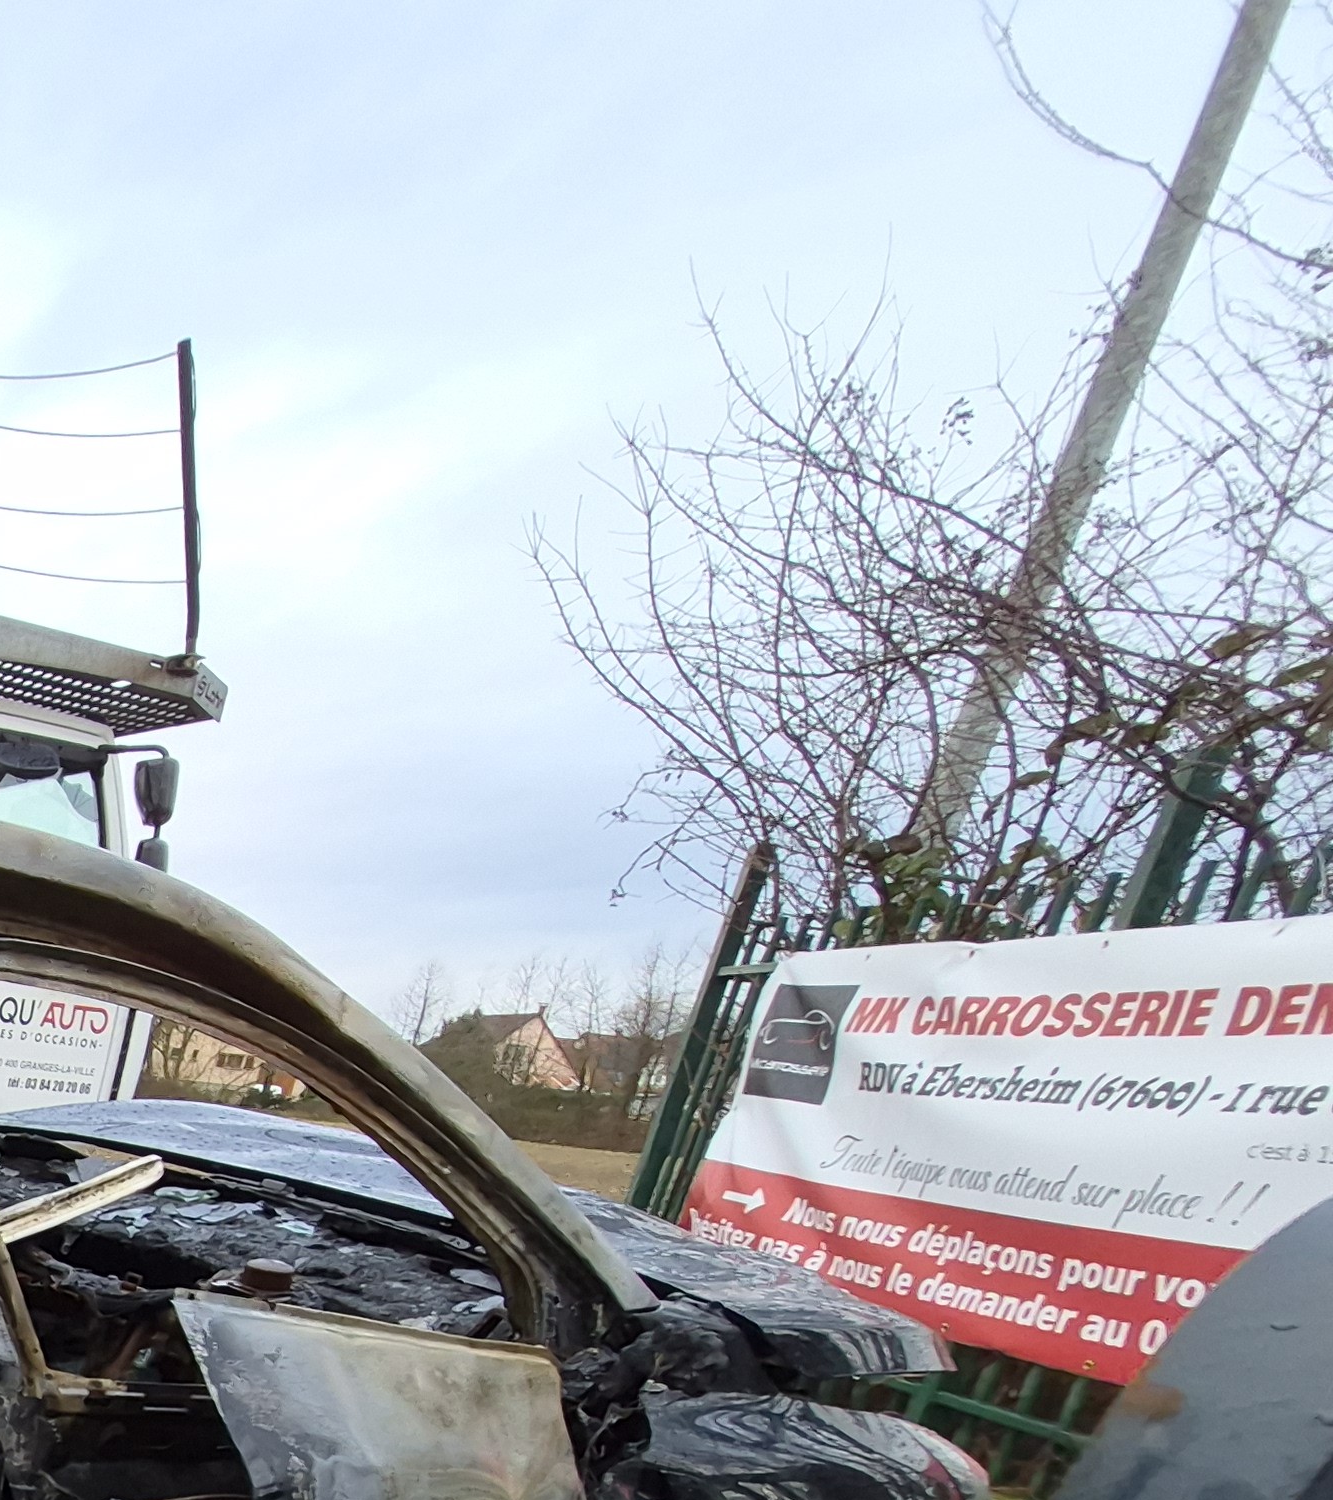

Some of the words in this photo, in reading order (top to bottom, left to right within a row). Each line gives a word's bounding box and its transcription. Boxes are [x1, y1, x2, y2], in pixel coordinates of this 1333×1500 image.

[845, 996, 910, 1034] MK
[912, 988, 1221, 1037] CARROSSERIE
[20, 1060, 96, 1077] GRANGES-LA-VILLE
[52, 1080, 65, 1092] 20
[65, 1081, 78, 1093] 20
[858, 1062, 907, 1094] RDV
[901, 1061, 924, 1093] à
[916, 1063, 1083, 1104] Ebersheim
[1077, 1073, 1213, 1118] (67600)
[1244, 1084, 1330, 1116] rue
[1246, 1143, 1294, 1161] c'est
[820, 1134, 884, 1175] Toute
[881, 1145, 947, 1198] l'équipe
[947, 1164, 993, 1193] vous
[993, 1164, 1079, 1203] attend
[1071, 1182, 1122, 1208] sur
[1111, 1173, 1205, 1228] place
[780, 1196, 837, 1233] Nous
[838, 1216, 908, 1248] nous
[907, 1223, 1055, 1275] déplaçons
[1056, 1258, 1149, 1296] pour
[1155, 1274, 1218, 1308] vo
[757, 1236, 805, 1263] pas
[803, 1242, 827, 1272] à
[827, 1255, 884, 1289] nous
[885, 1262, 915, 1296] le
[916, 1272, 1081, 1334] demander
[1080, 1314, 1132, 1349] au
